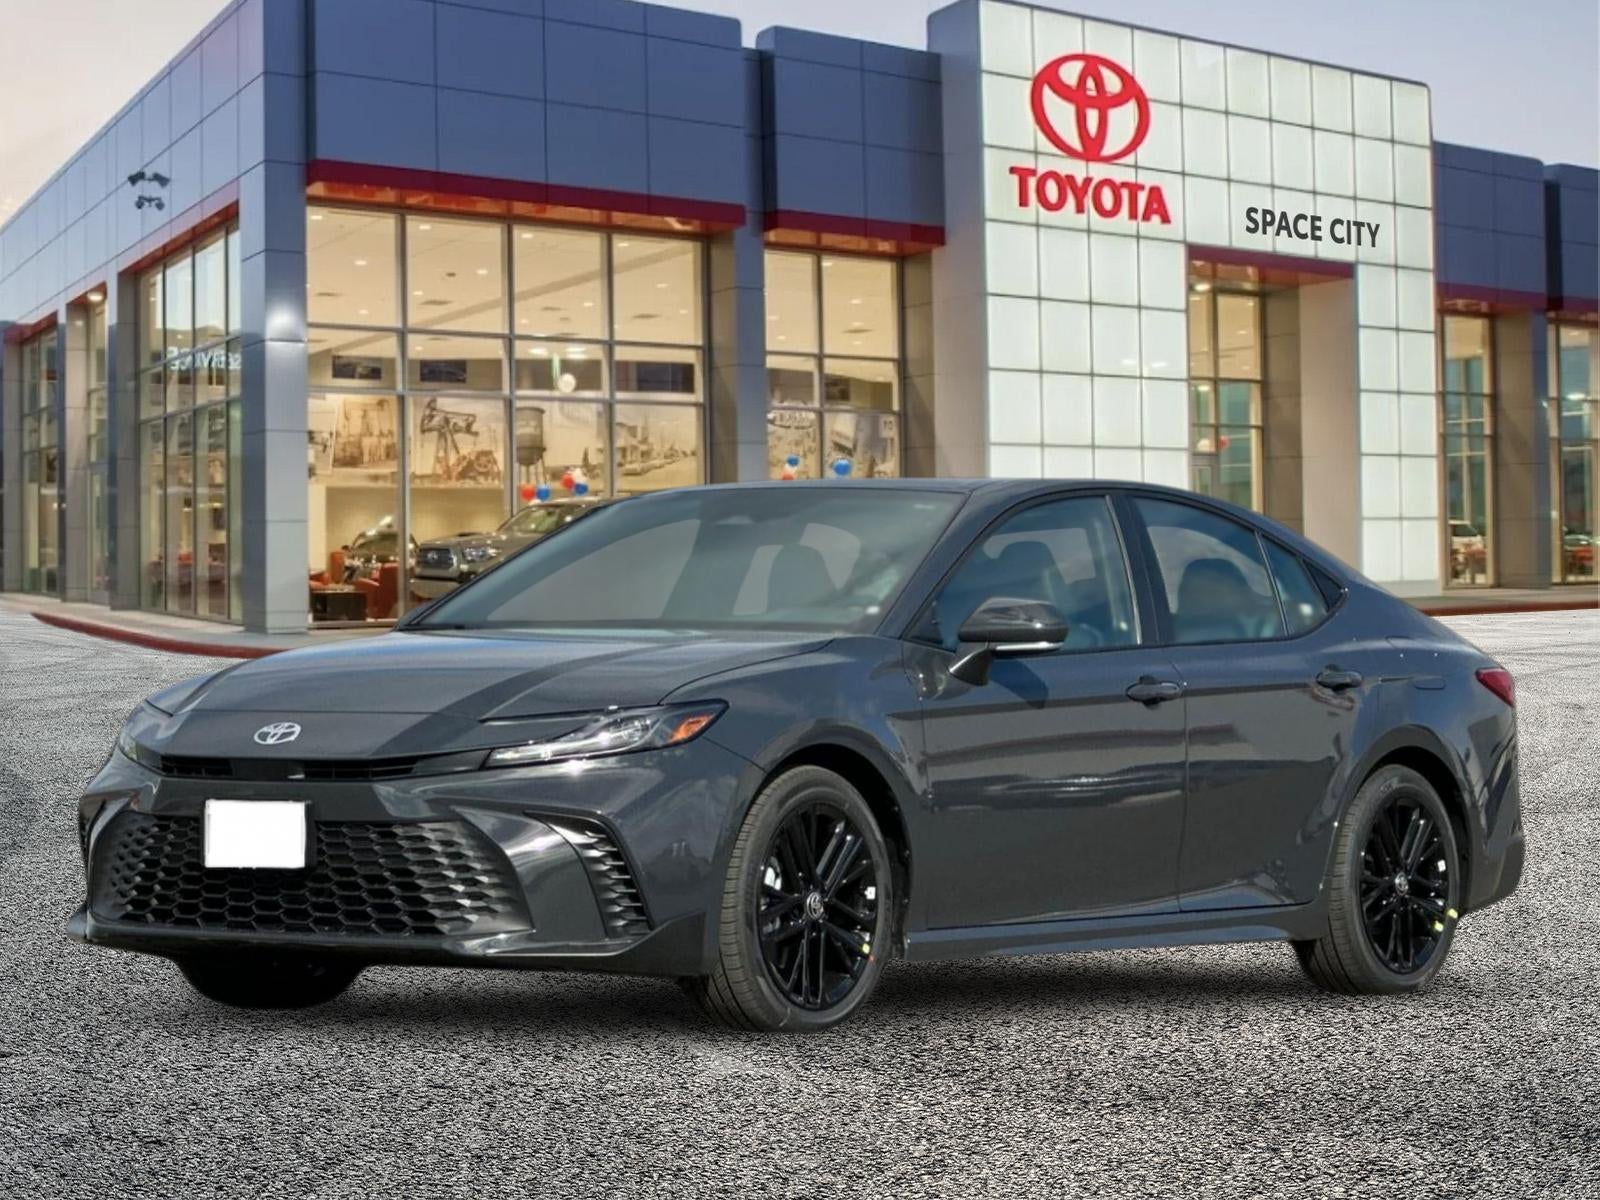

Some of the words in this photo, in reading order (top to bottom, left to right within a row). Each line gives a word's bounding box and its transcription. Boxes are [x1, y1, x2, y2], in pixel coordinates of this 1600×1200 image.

[1009, 166, 1171, 224] TOYOTA
[1245, 207, 1323, 242] SPACE
[1329, 218, 1381, 248] CITY
